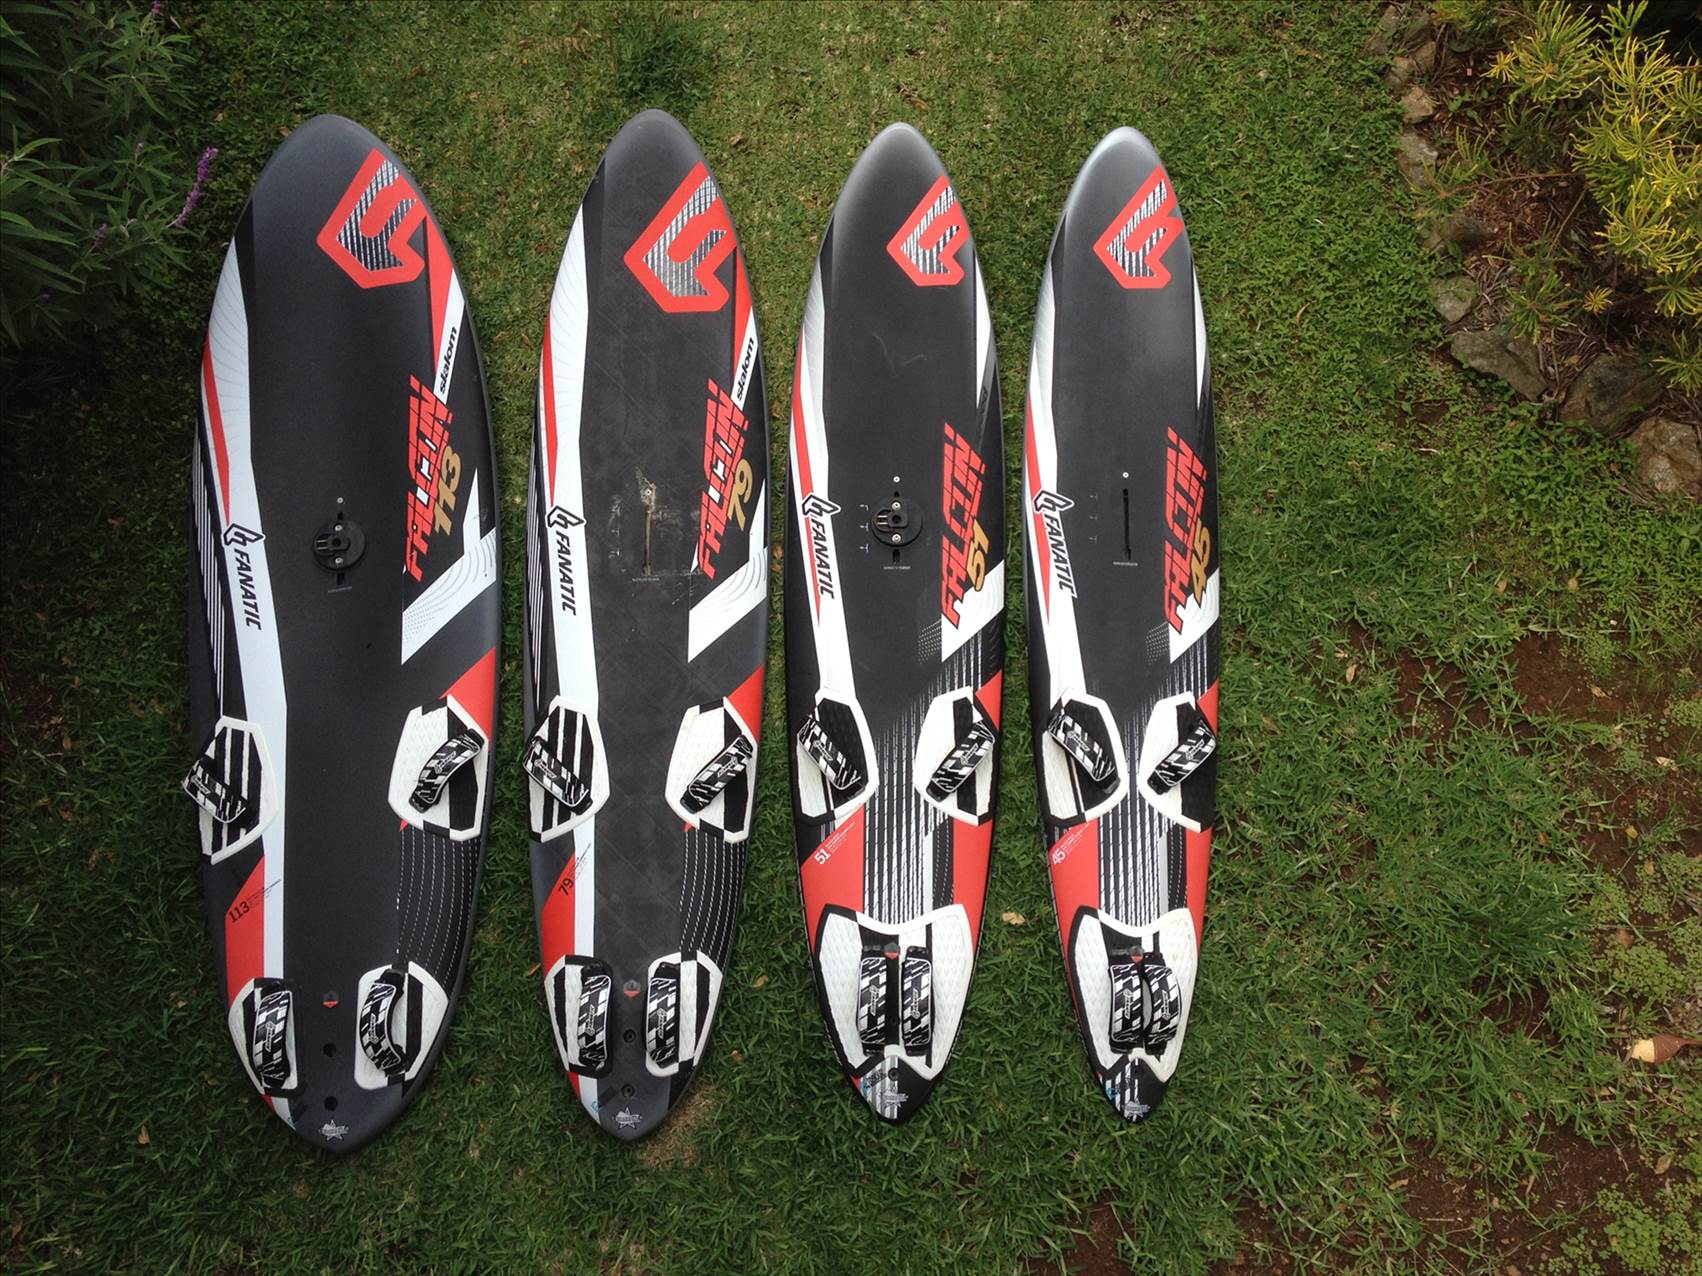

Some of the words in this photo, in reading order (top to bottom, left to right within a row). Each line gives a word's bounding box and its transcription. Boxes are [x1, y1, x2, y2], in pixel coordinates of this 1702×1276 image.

[439, 326, 458, 394] slalom
[735, 337, 756, 402] slalom
[435, 445, 461, 536] 113
[727, 458, 752, 531] 79
[235, 550, 261, 630] FANATIC
[556, 533, 576, 615] FANATIC
[811, 516, 834, 599] FANATIC
[966, 519, 990, 592] 51
[1045, 512, 1076, 597] FANATIC
[1191, 517, 1211, 608] 45
[558, 878, 574, 896] 79
[814, 848, 831, 864] 51
[1052, 849, 1066, 865] 45
[228, 901, 250, 923] 113
